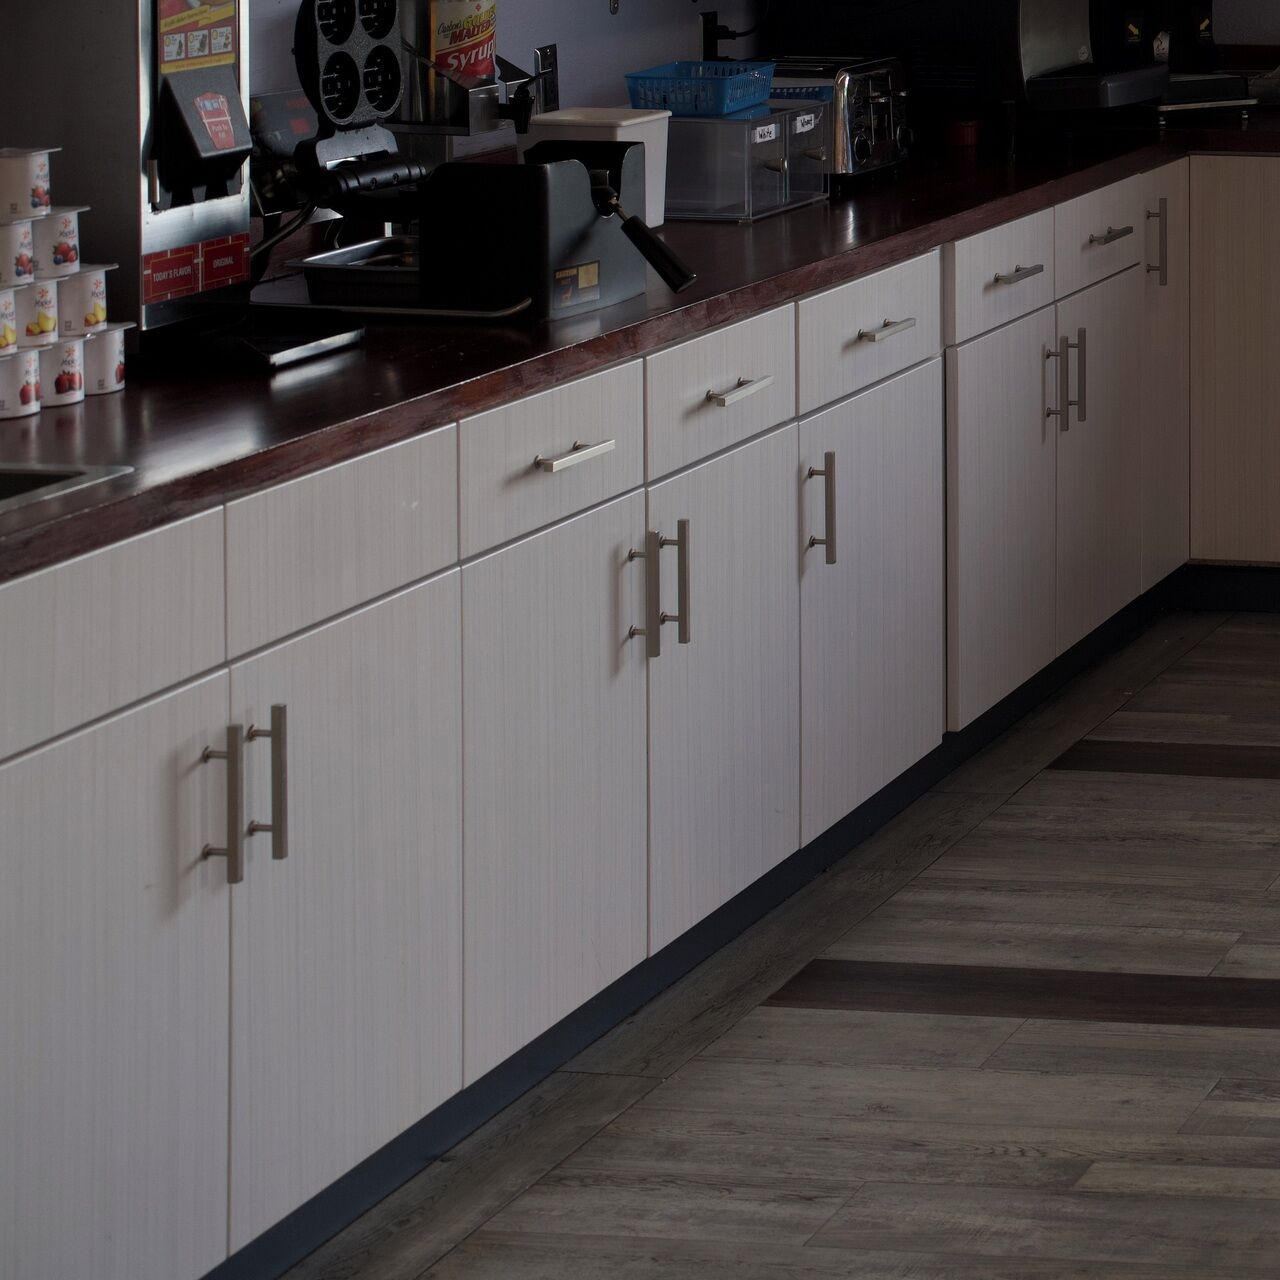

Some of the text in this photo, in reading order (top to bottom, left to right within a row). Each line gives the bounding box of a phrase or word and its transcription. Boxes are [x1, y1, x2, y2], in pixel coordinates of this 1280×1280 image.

[450, 20, 490, 45] MALTED
[448, 39, 496, 70] Syrup
[212, 255, 234, 268] ORIGINAL
[153, 266, 192, 283] TODAY'S FLAVOR
